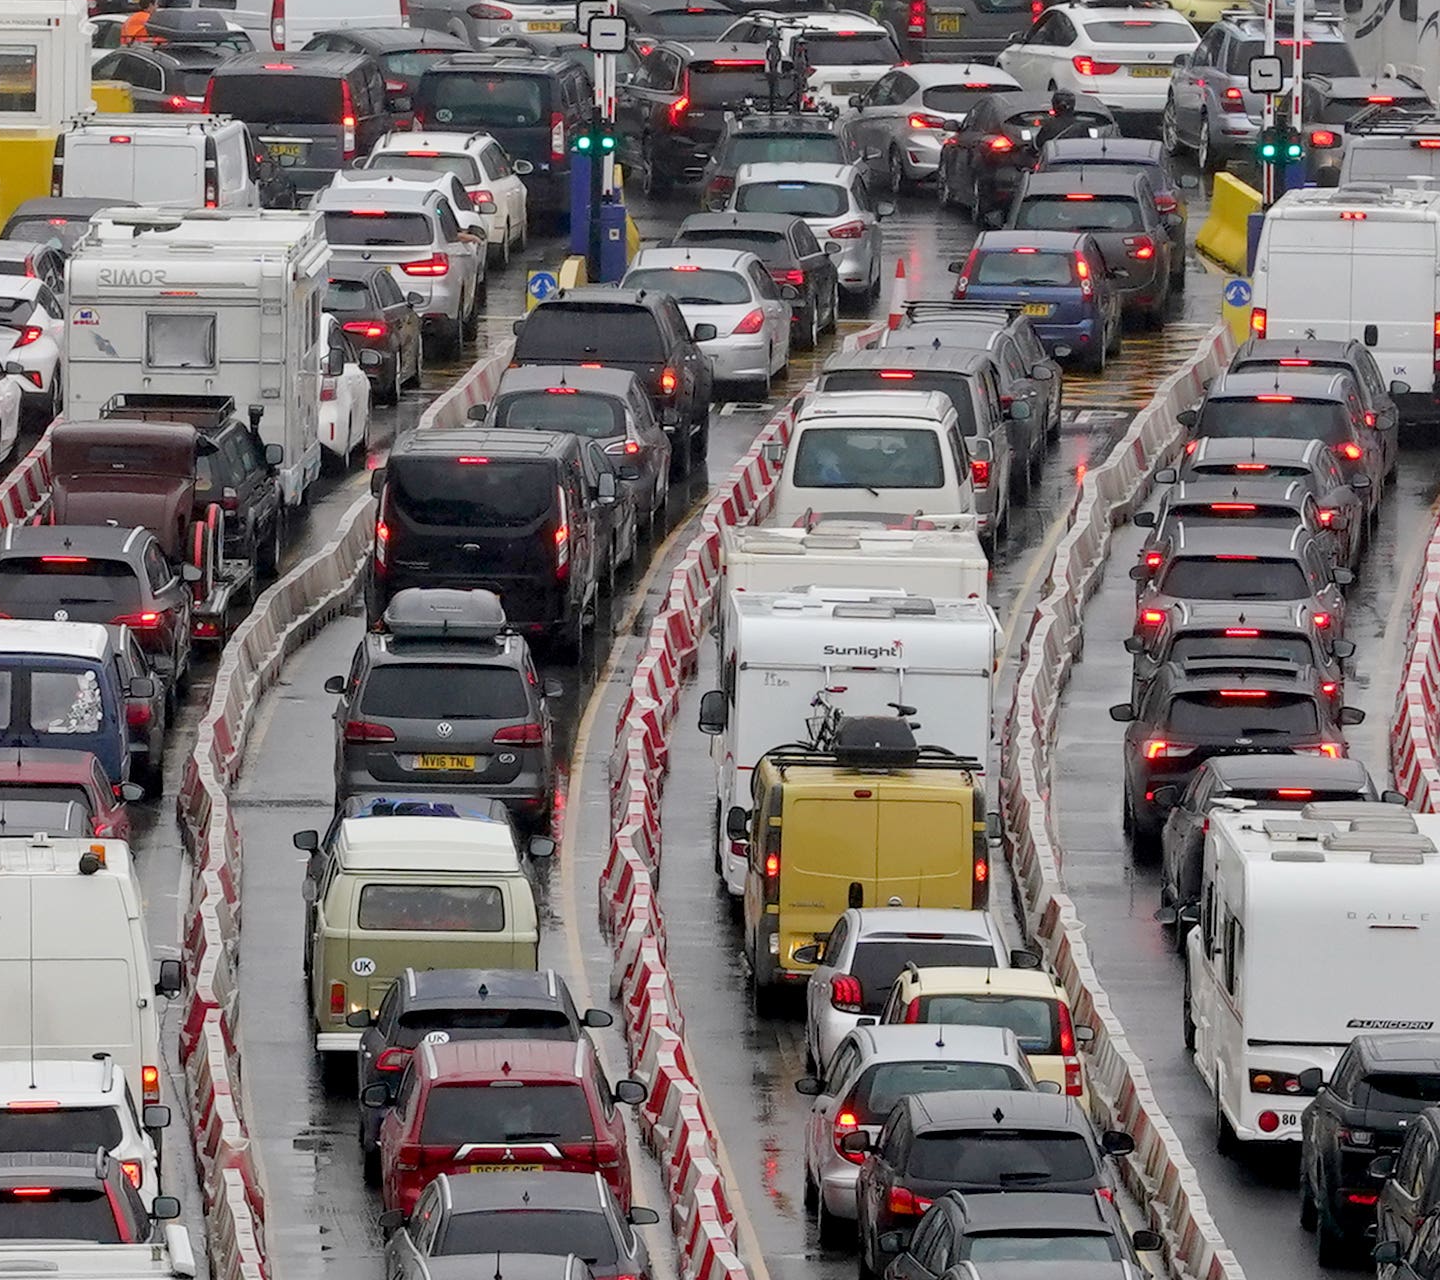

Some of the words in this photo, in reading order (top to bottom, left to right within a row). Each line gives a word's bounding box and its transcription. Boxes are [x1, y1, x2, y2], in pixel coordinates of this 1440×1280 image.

[439, 111, 450, 119] UK
[1393, 366, 1407, 375] UK
[823, 644, 897, 659] Sunlight
[422, 755, 447, 767] NV16
[450, 756, 471, 767] TNL
[355, 961, 372, 972] UK
[1358, 1020, 1432, 1029] UNICORN
[428, 1034, 445, 1043] UK
[1282, 1114, 1296, 1125] 80
